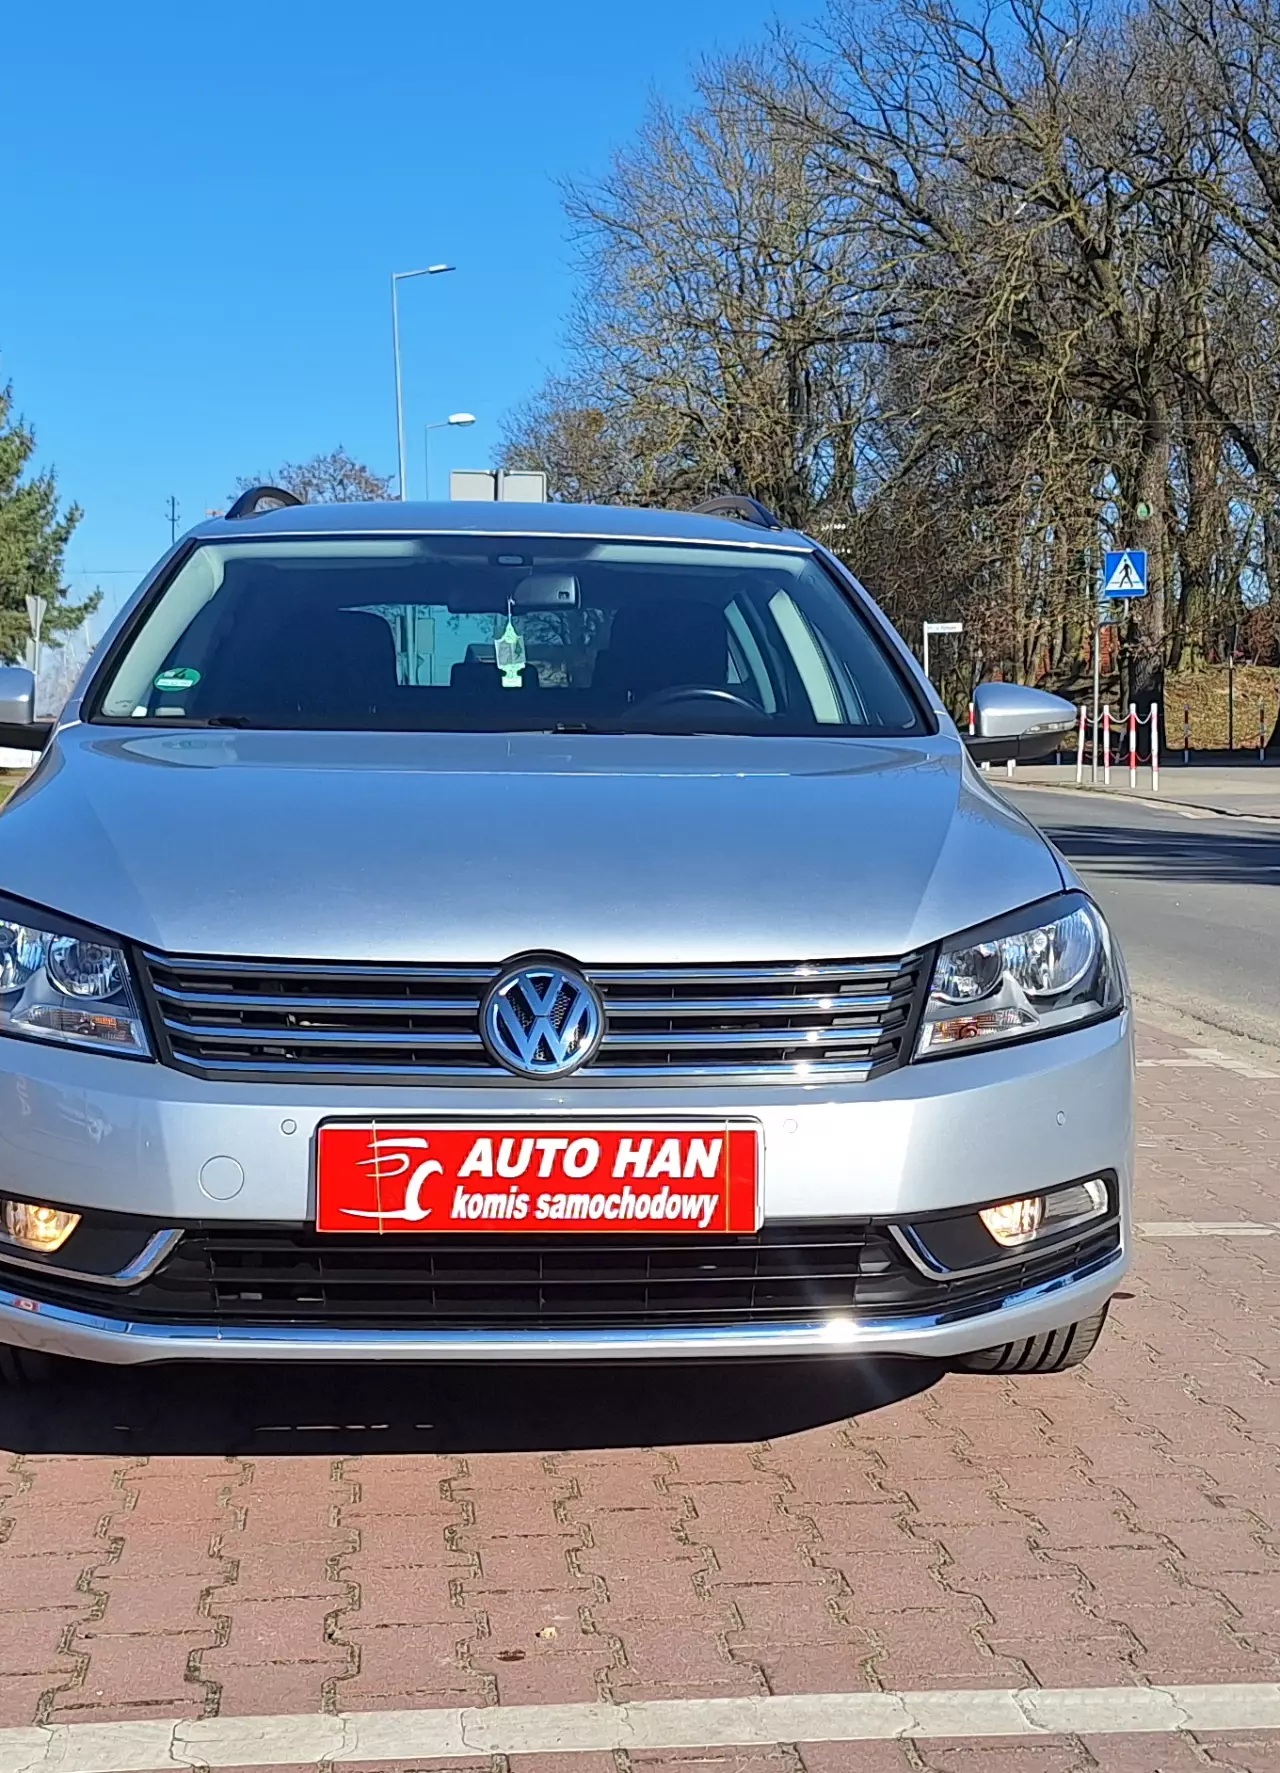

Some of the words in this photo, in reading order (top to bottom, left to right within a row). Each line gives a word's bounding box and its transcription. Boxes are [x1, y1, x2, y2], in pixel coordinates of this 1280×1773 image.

[489, 968, 596, 1071] VW
[457, 1138, 599, 1178] AUTO
[611, 1138, 722, 1178] HAN
[450, 1185, 529, 1220] komis
[535, 1186, 719, 1229] samochodowy
